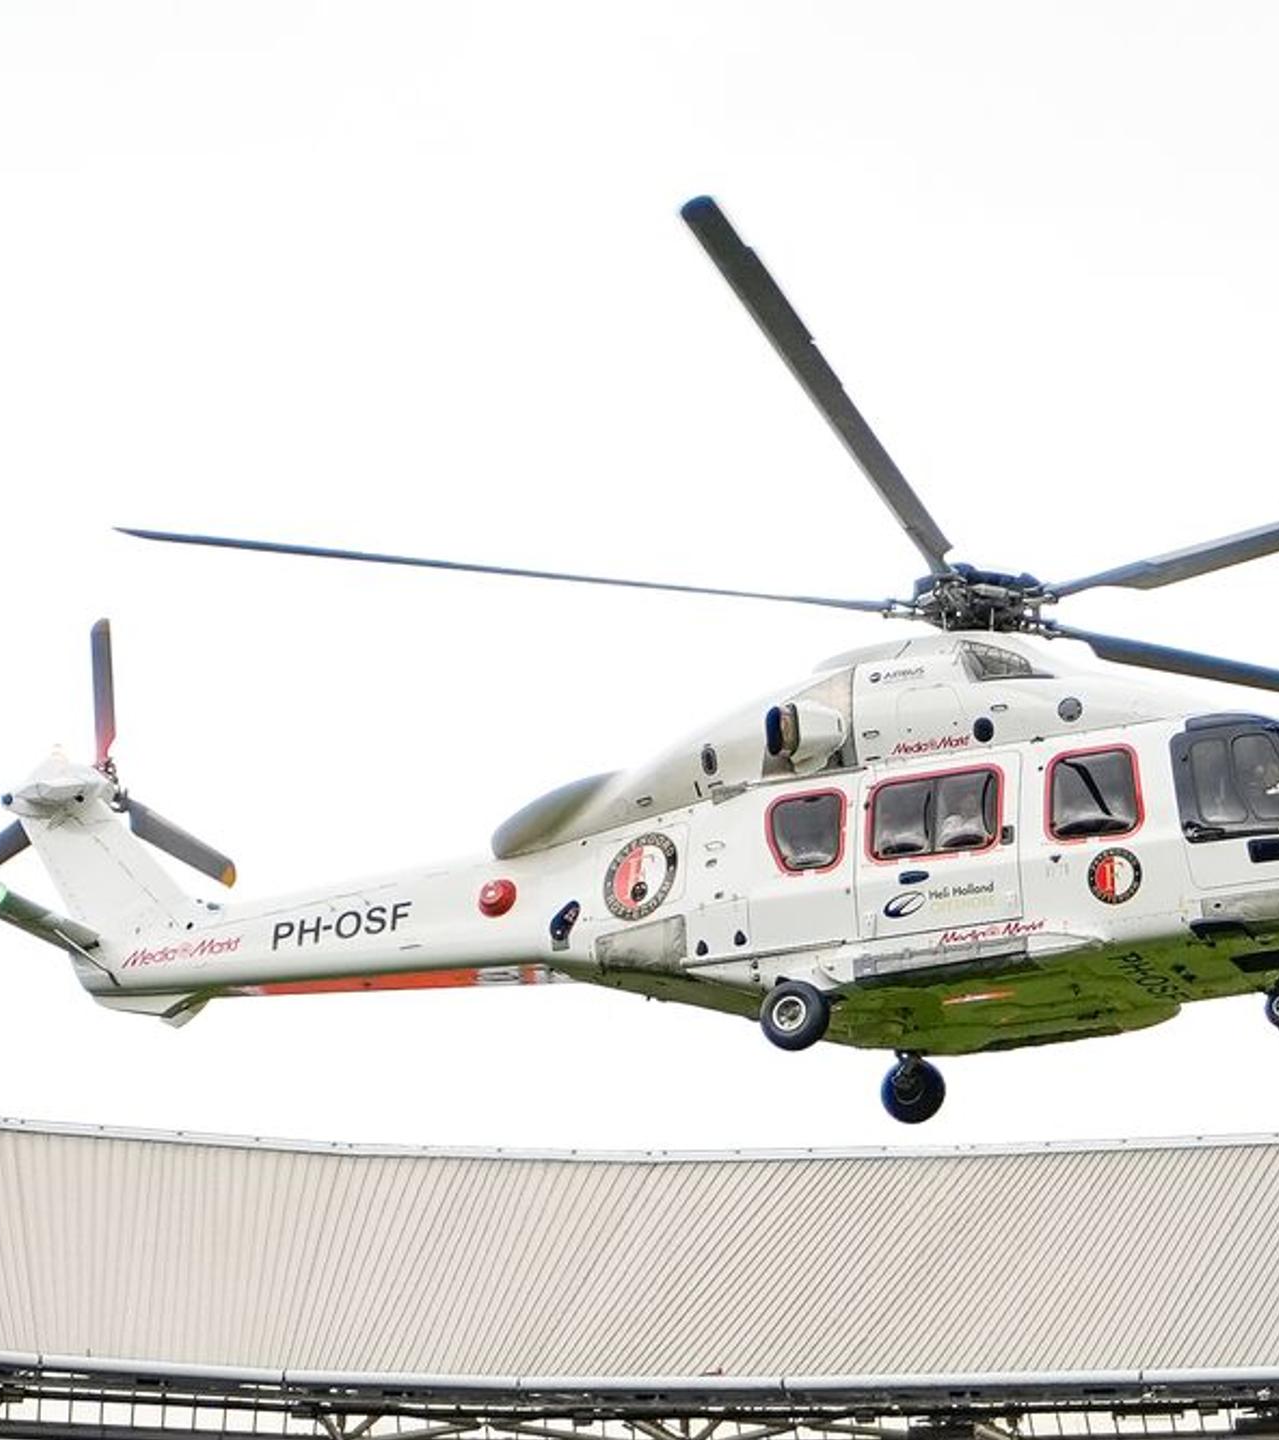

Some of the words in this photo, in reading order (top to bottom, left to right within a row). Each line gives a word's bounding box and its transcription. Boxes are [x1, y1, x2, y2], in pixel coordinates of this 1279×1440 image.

[928, 887, 950, 900] Heli
[951, 881, 995, 898] Holland
[272, 901, 412, 950] PH-OSF
[122, 948, 178, 969] Media
